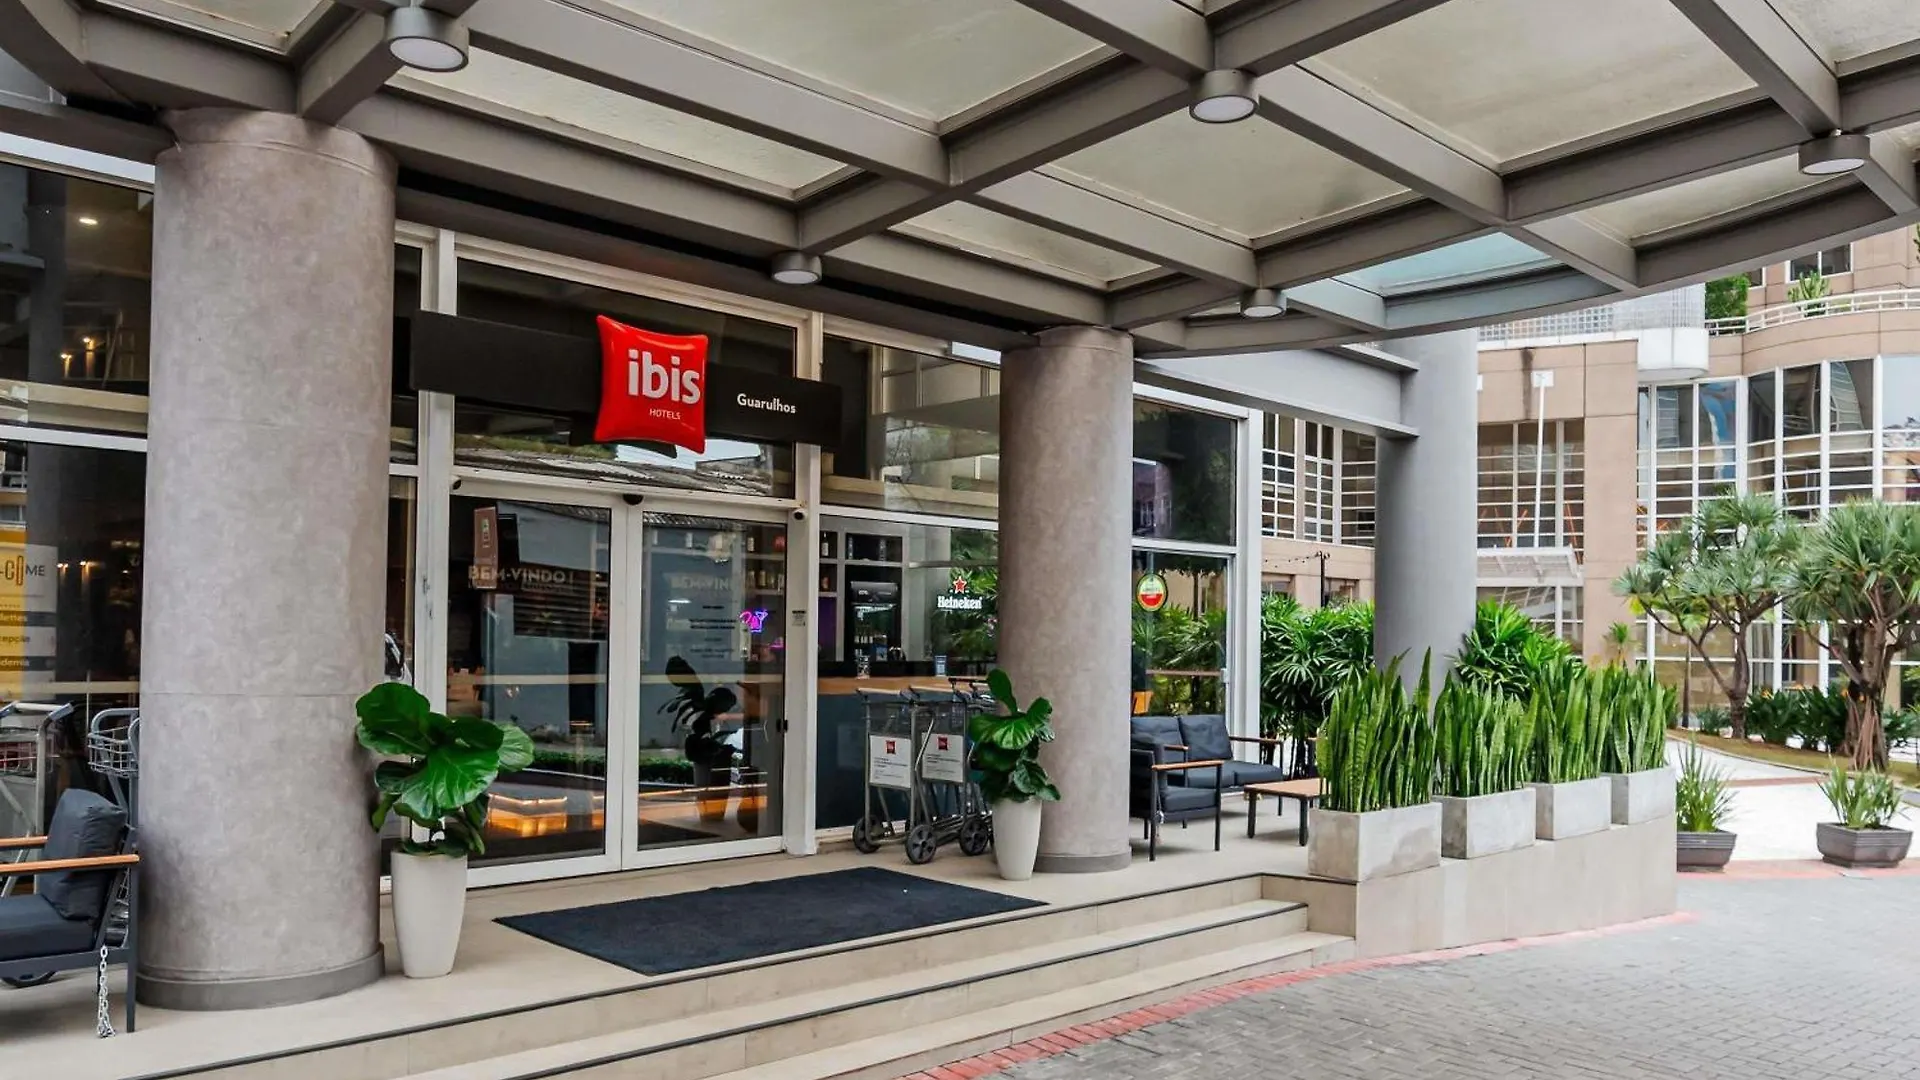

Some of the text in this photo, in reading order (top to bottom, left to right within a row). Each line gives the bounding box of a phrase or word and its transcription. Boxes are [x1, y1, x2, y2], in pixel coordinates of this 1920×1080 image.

[627, 348, 701, 405] ibis
[736, 392, 796, 414] Guarulhos
[650, 408, 681, 420] HOTELS
[937, 595, 983, 610] Heineken
